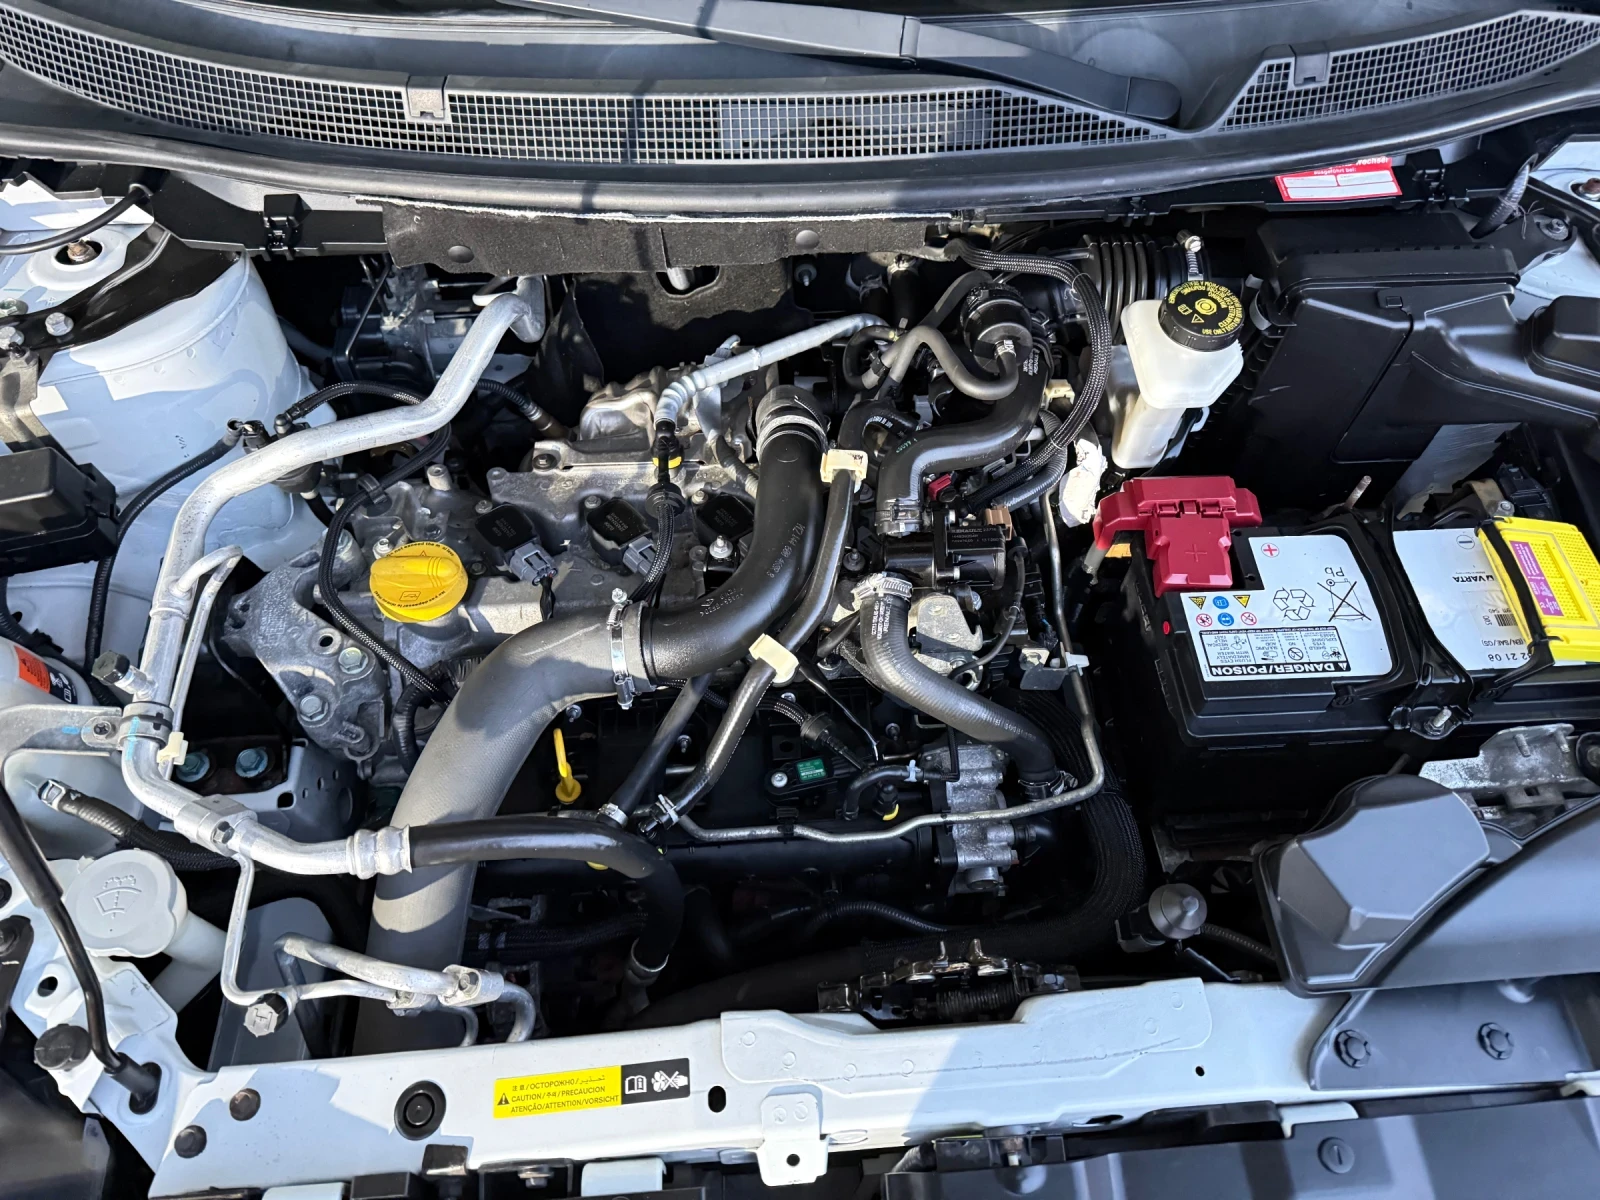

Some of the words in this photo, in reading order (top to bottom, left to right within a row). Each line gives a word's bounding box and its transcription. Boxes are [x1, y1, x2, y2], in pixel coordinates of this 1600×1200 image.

[1324, 567, 1344, 577] Pb
[1506, 653, 1518, 661] 21
[1212, 662, 1336, 676] DANGER/POISON
